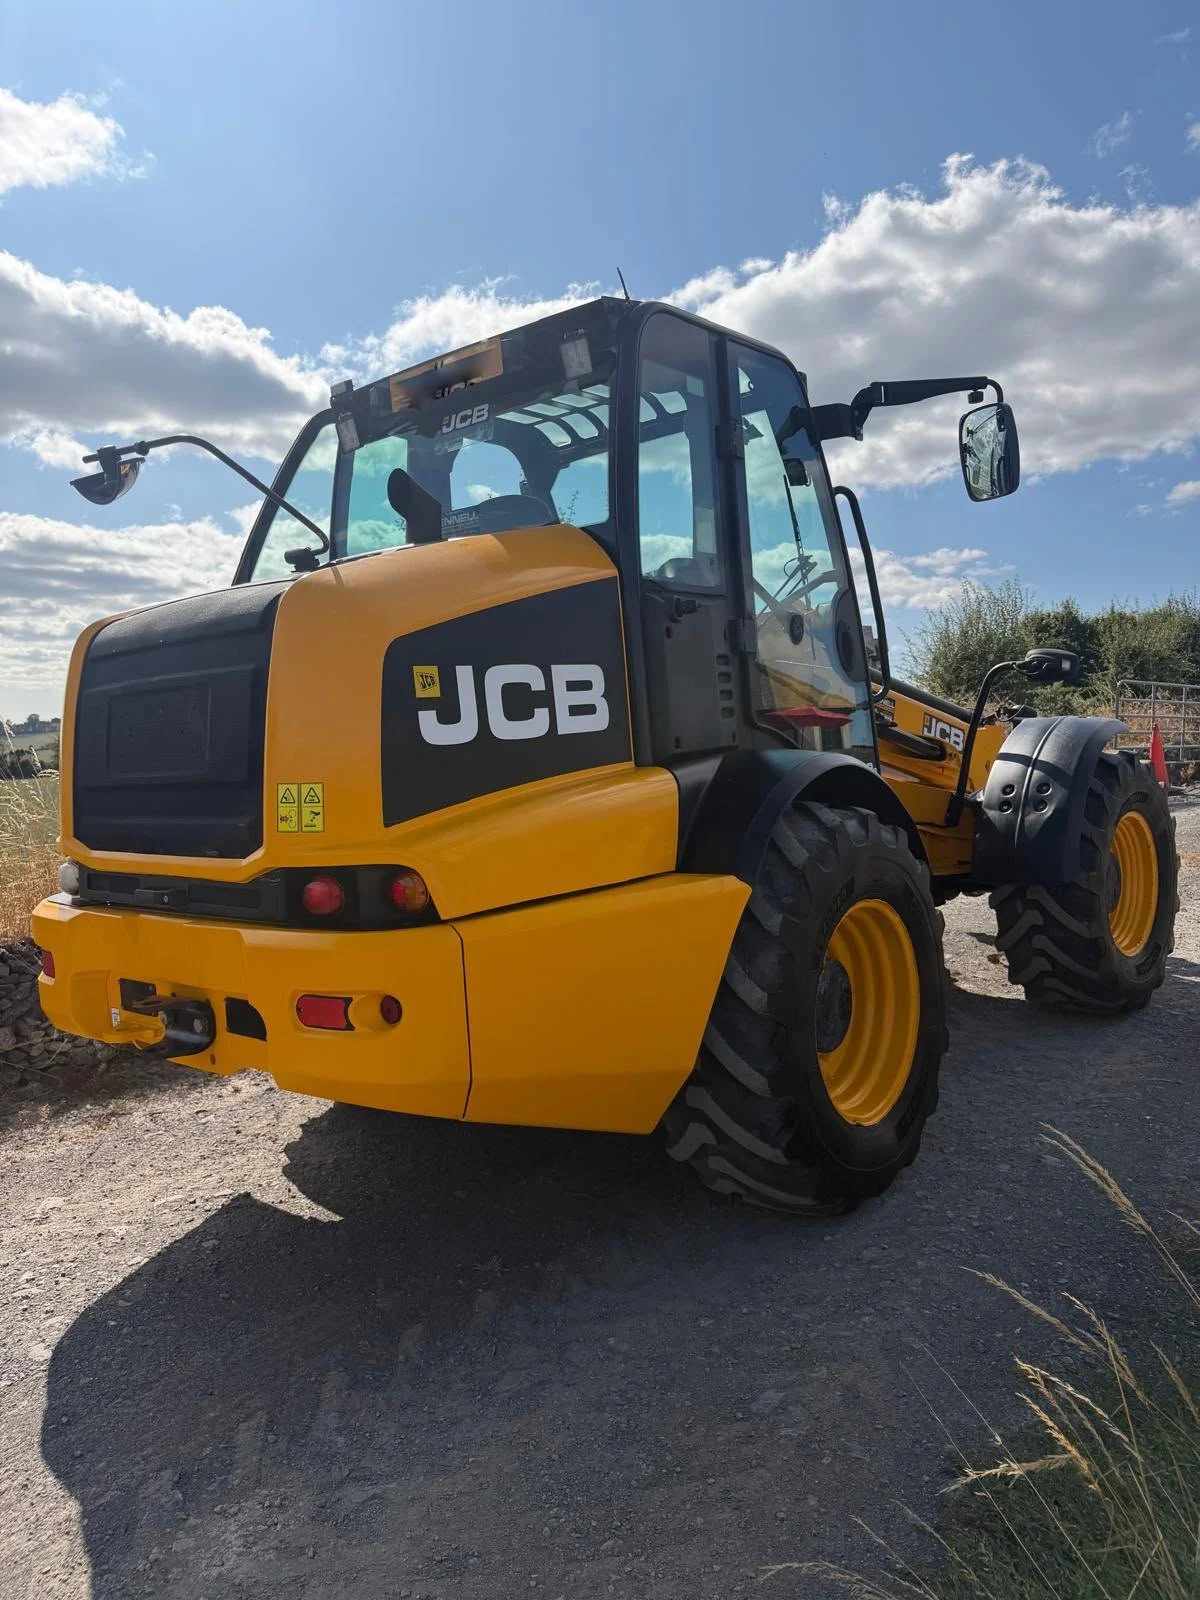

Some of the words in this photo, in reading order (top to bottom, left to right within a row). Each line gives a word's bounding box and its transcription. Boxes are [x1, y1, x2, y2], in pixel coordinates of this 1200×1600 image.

[442, 403, 489, 434] JCB
[419, 673, 436, 689] JCB
[418, 664, 609, 745] JCB
[924, 715, 965, 752] JCB
